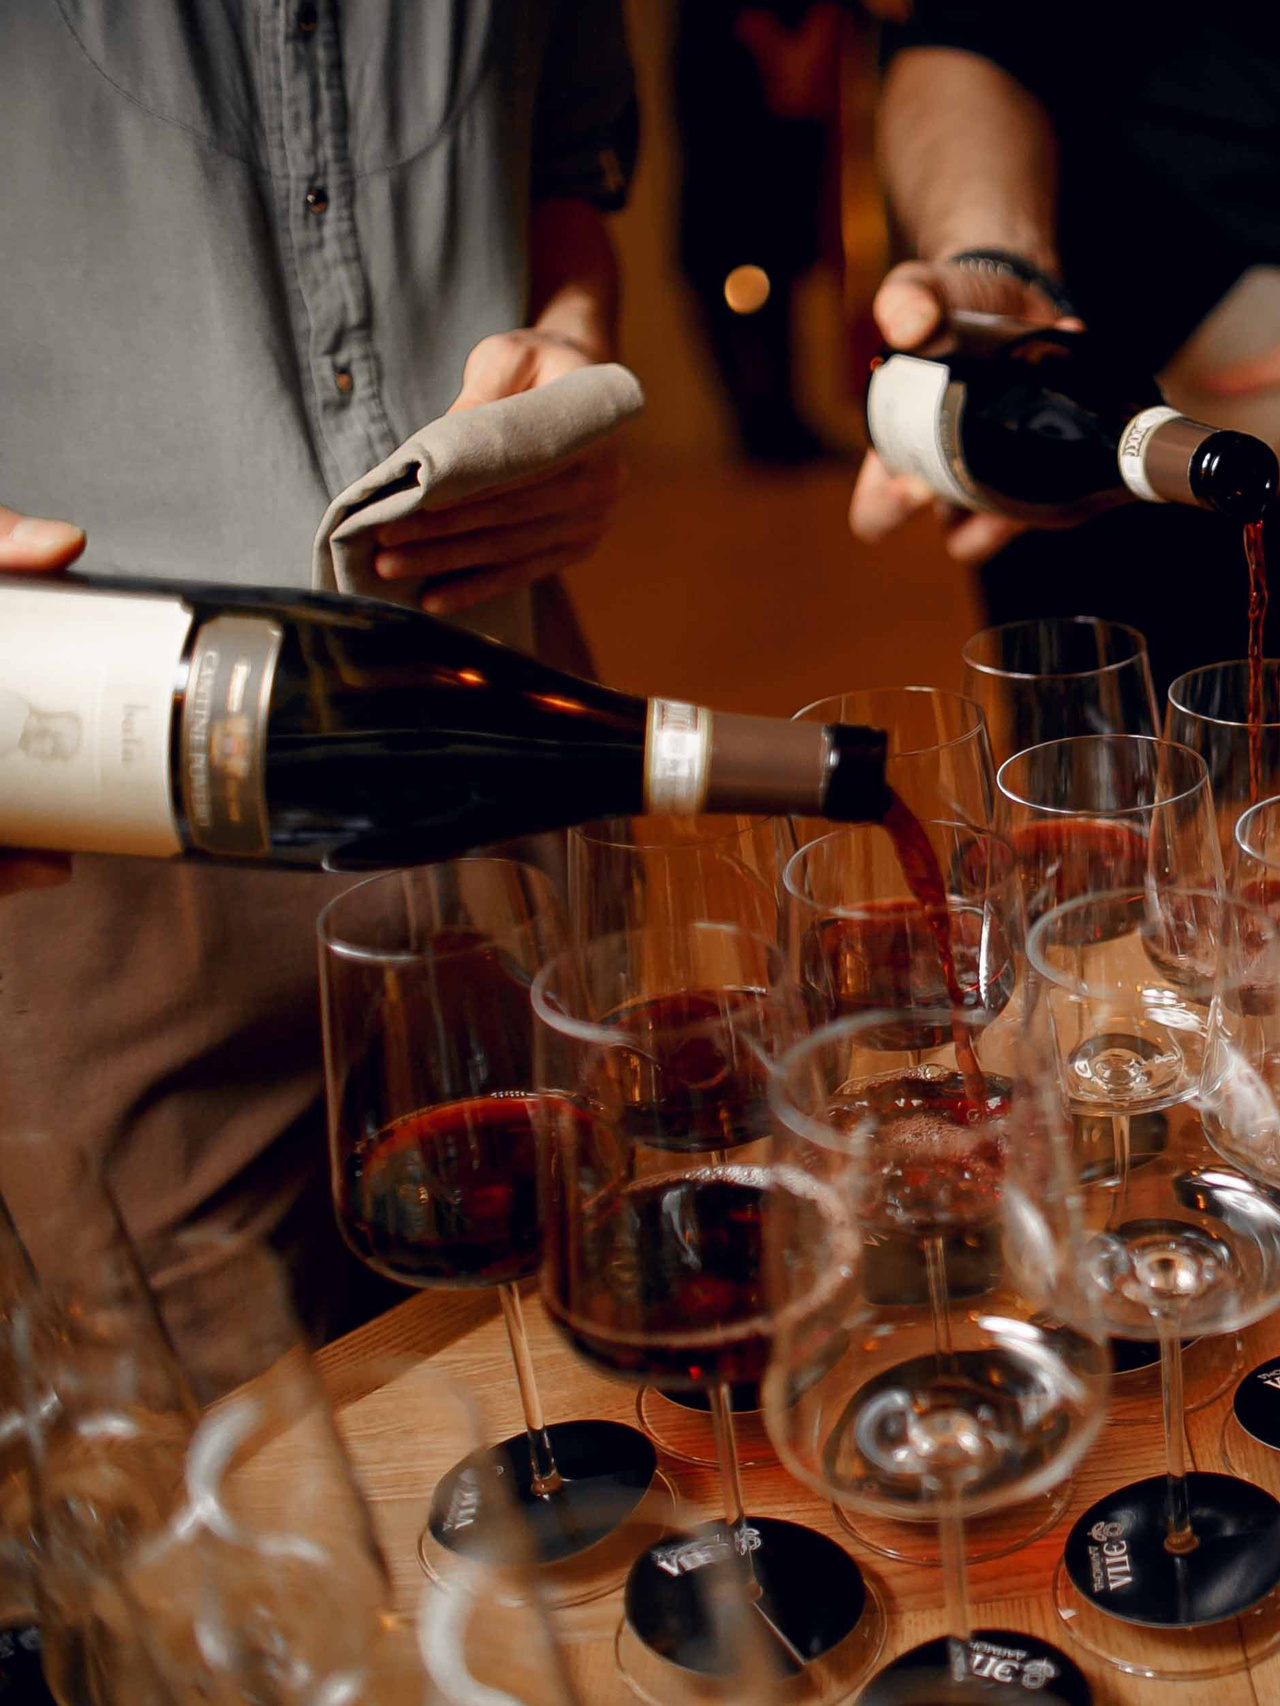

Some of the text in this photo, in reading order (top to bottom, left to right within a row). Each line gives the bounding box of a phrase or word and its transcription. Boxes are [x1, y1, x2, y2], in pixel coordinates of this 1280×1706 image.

[189, 650, 221, 746] CANTINE
[1103, 1540, 1133, 1591] ЭПЛ
[971, 1654, 1020, 1684] ЭП
